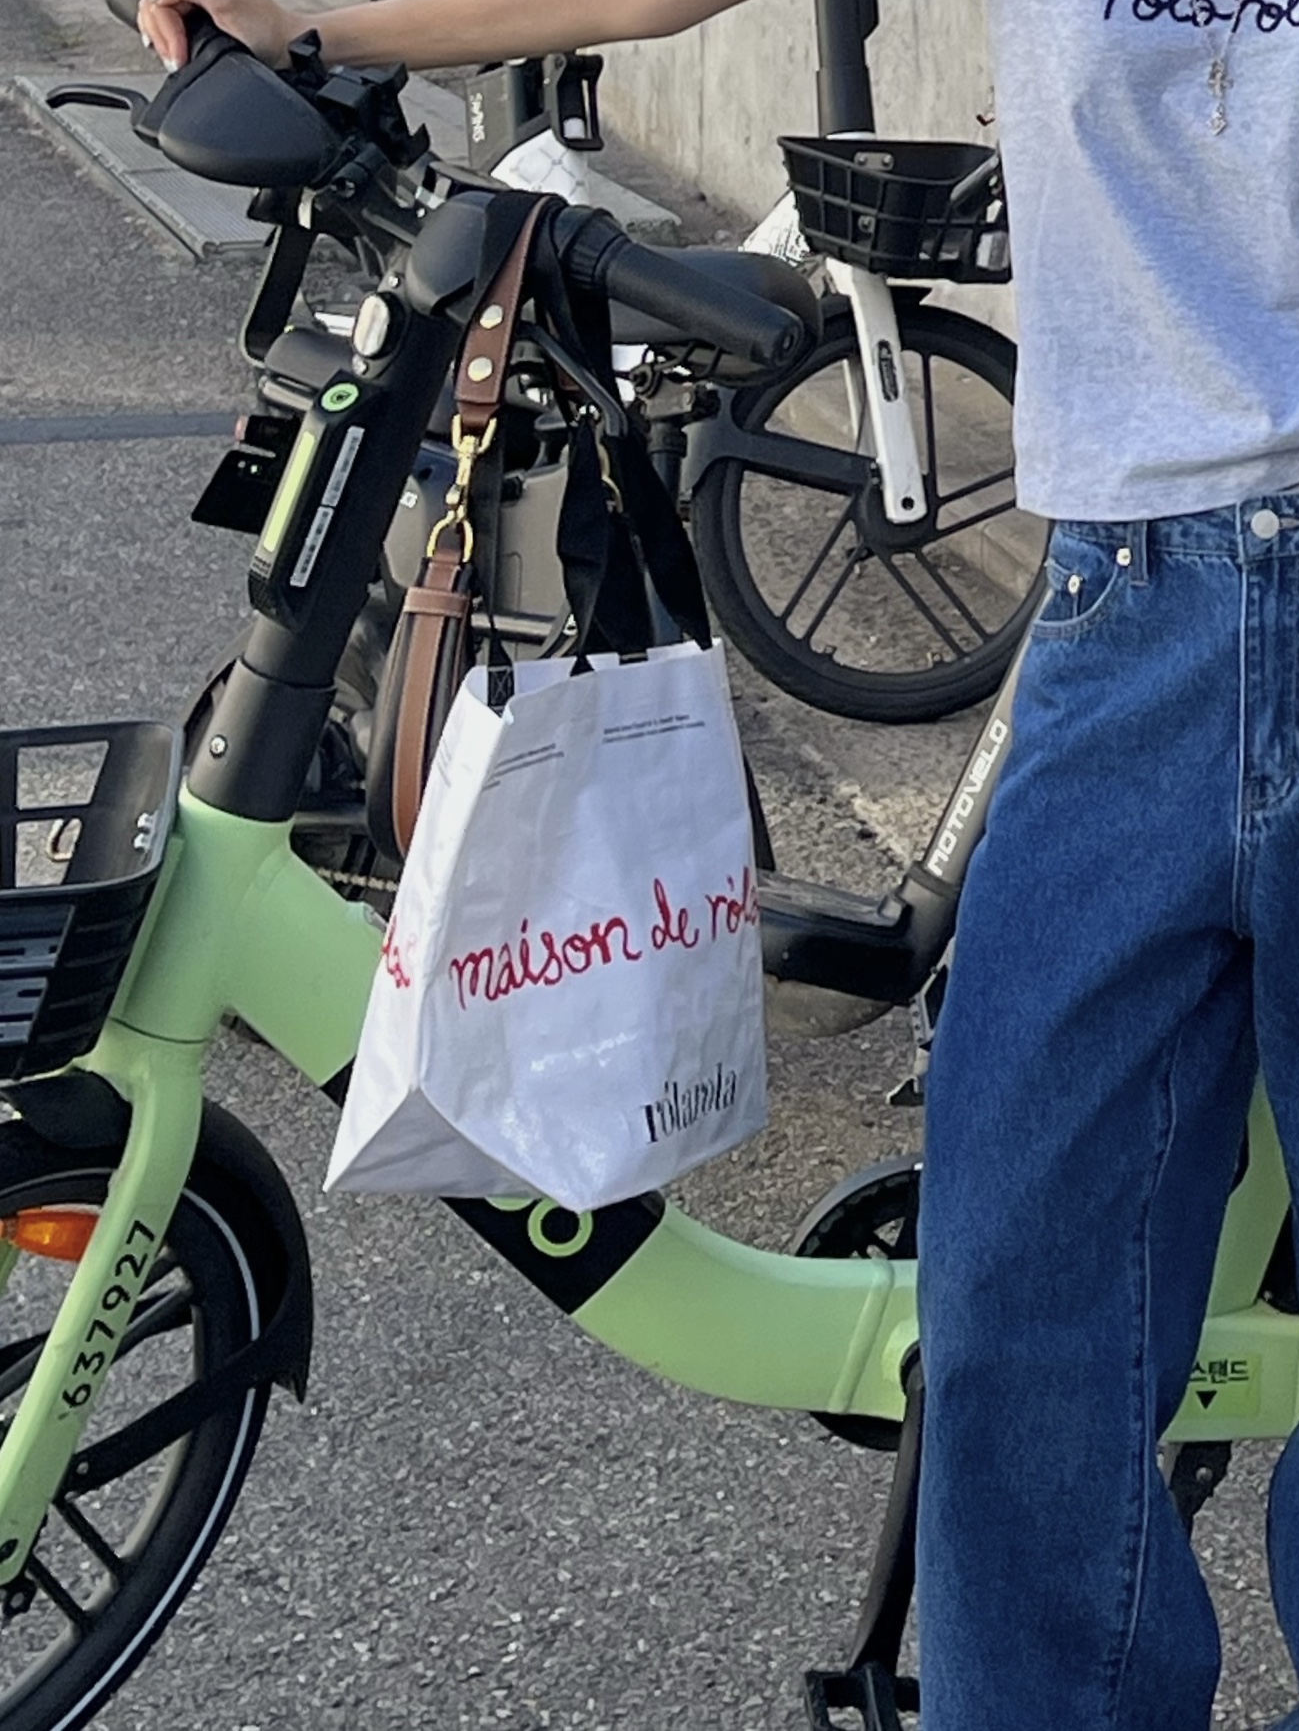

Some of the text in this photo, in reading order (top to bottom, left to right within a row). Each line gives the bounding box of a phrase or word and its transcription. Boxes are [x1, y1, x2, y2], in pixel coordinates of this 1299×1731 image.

[449, 917, 643, 1010] maison
[651, 878, 700, 951] de
[61, 1219, 156, 1409] 637927
